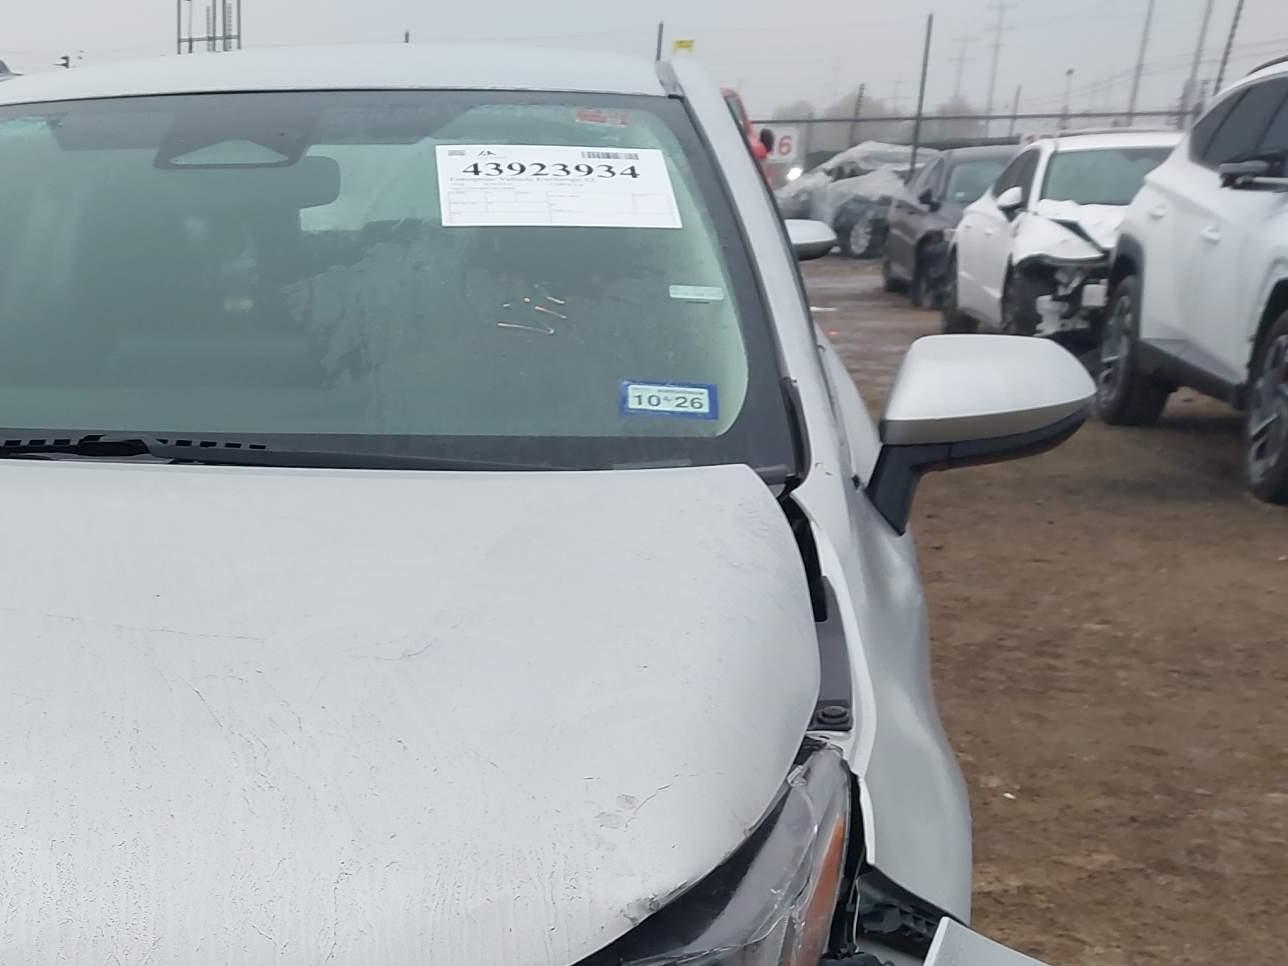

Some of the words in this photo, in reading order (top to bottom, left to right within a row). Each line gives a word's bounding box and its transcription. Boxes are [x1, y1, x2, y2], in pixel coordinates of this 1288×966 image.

[461, 161, 641, 179] 43923934
[633, 394, 661, 407] 10
[674, 396, 704, 410] 26
